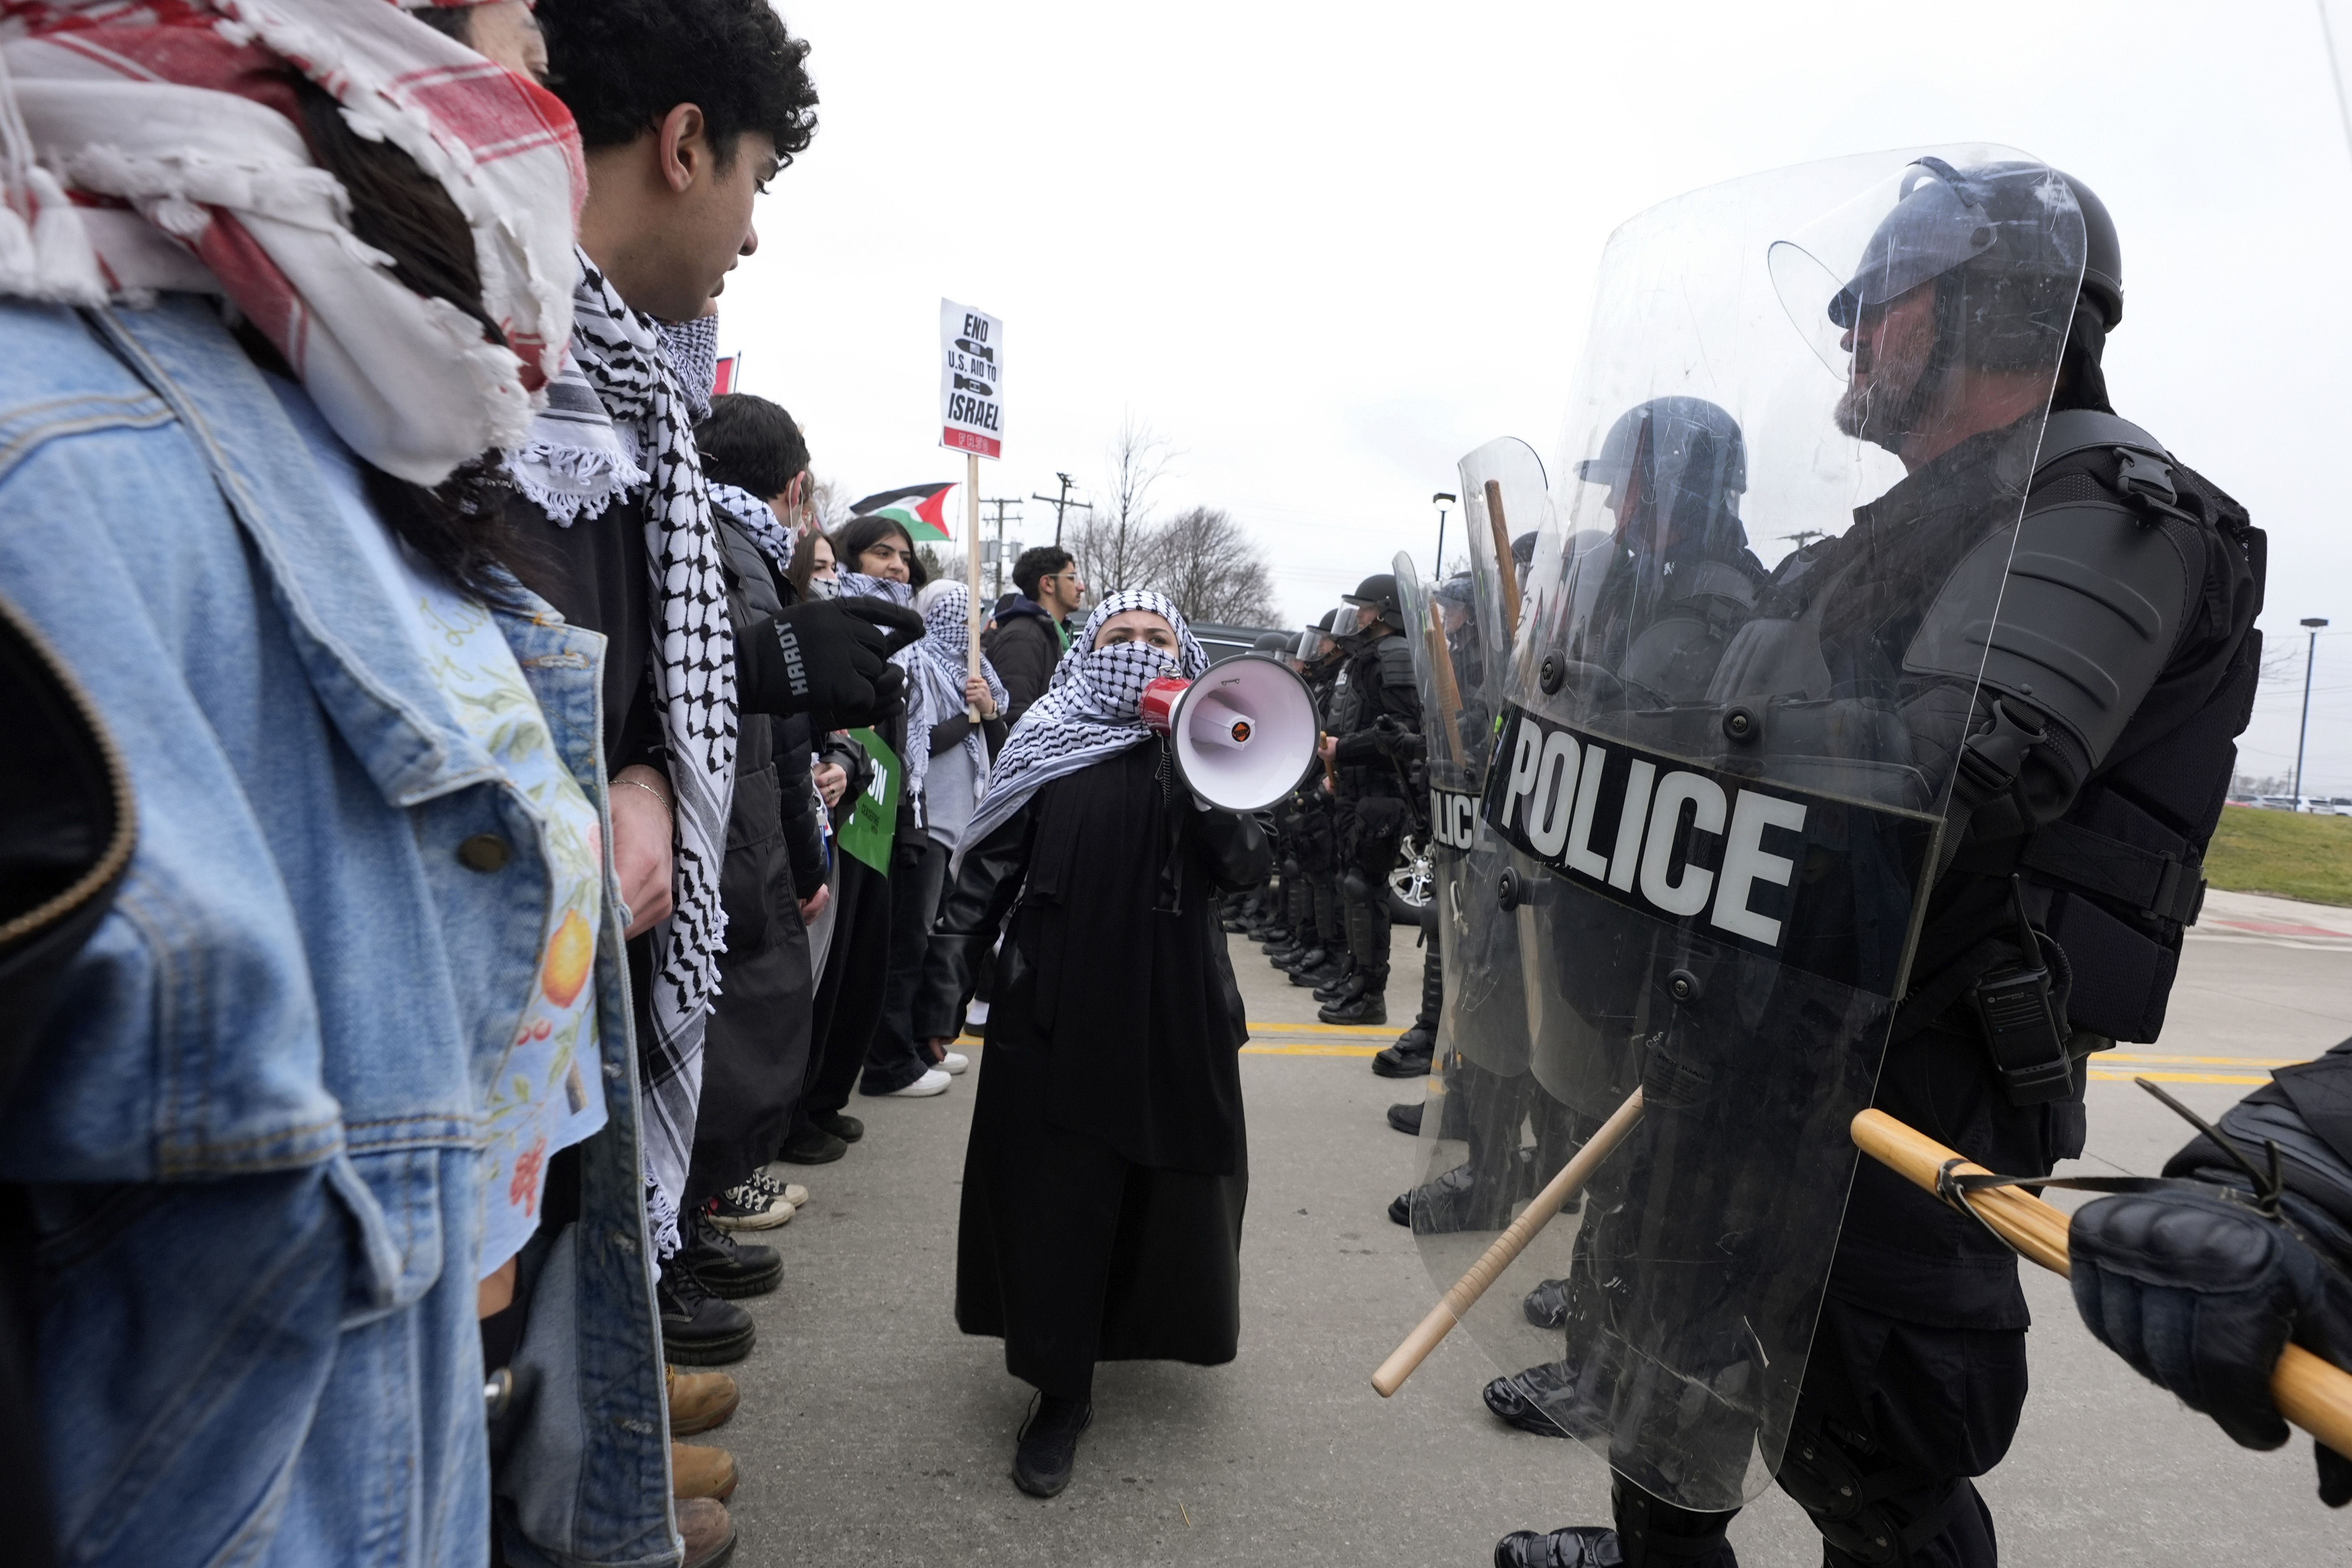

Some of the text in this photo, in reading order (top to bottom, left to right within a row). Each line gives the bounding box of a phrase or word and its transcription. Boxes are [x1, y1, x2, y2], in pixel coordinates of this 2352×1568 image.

[963, 313, 989, 343] END
[948, 350, 996, 382] U.S. AID TO
[947, 392, 999, 431] ISRAEL
[774, 621, 809, 696] HARDY
[1501, 716, 1807, 947] POLICE
